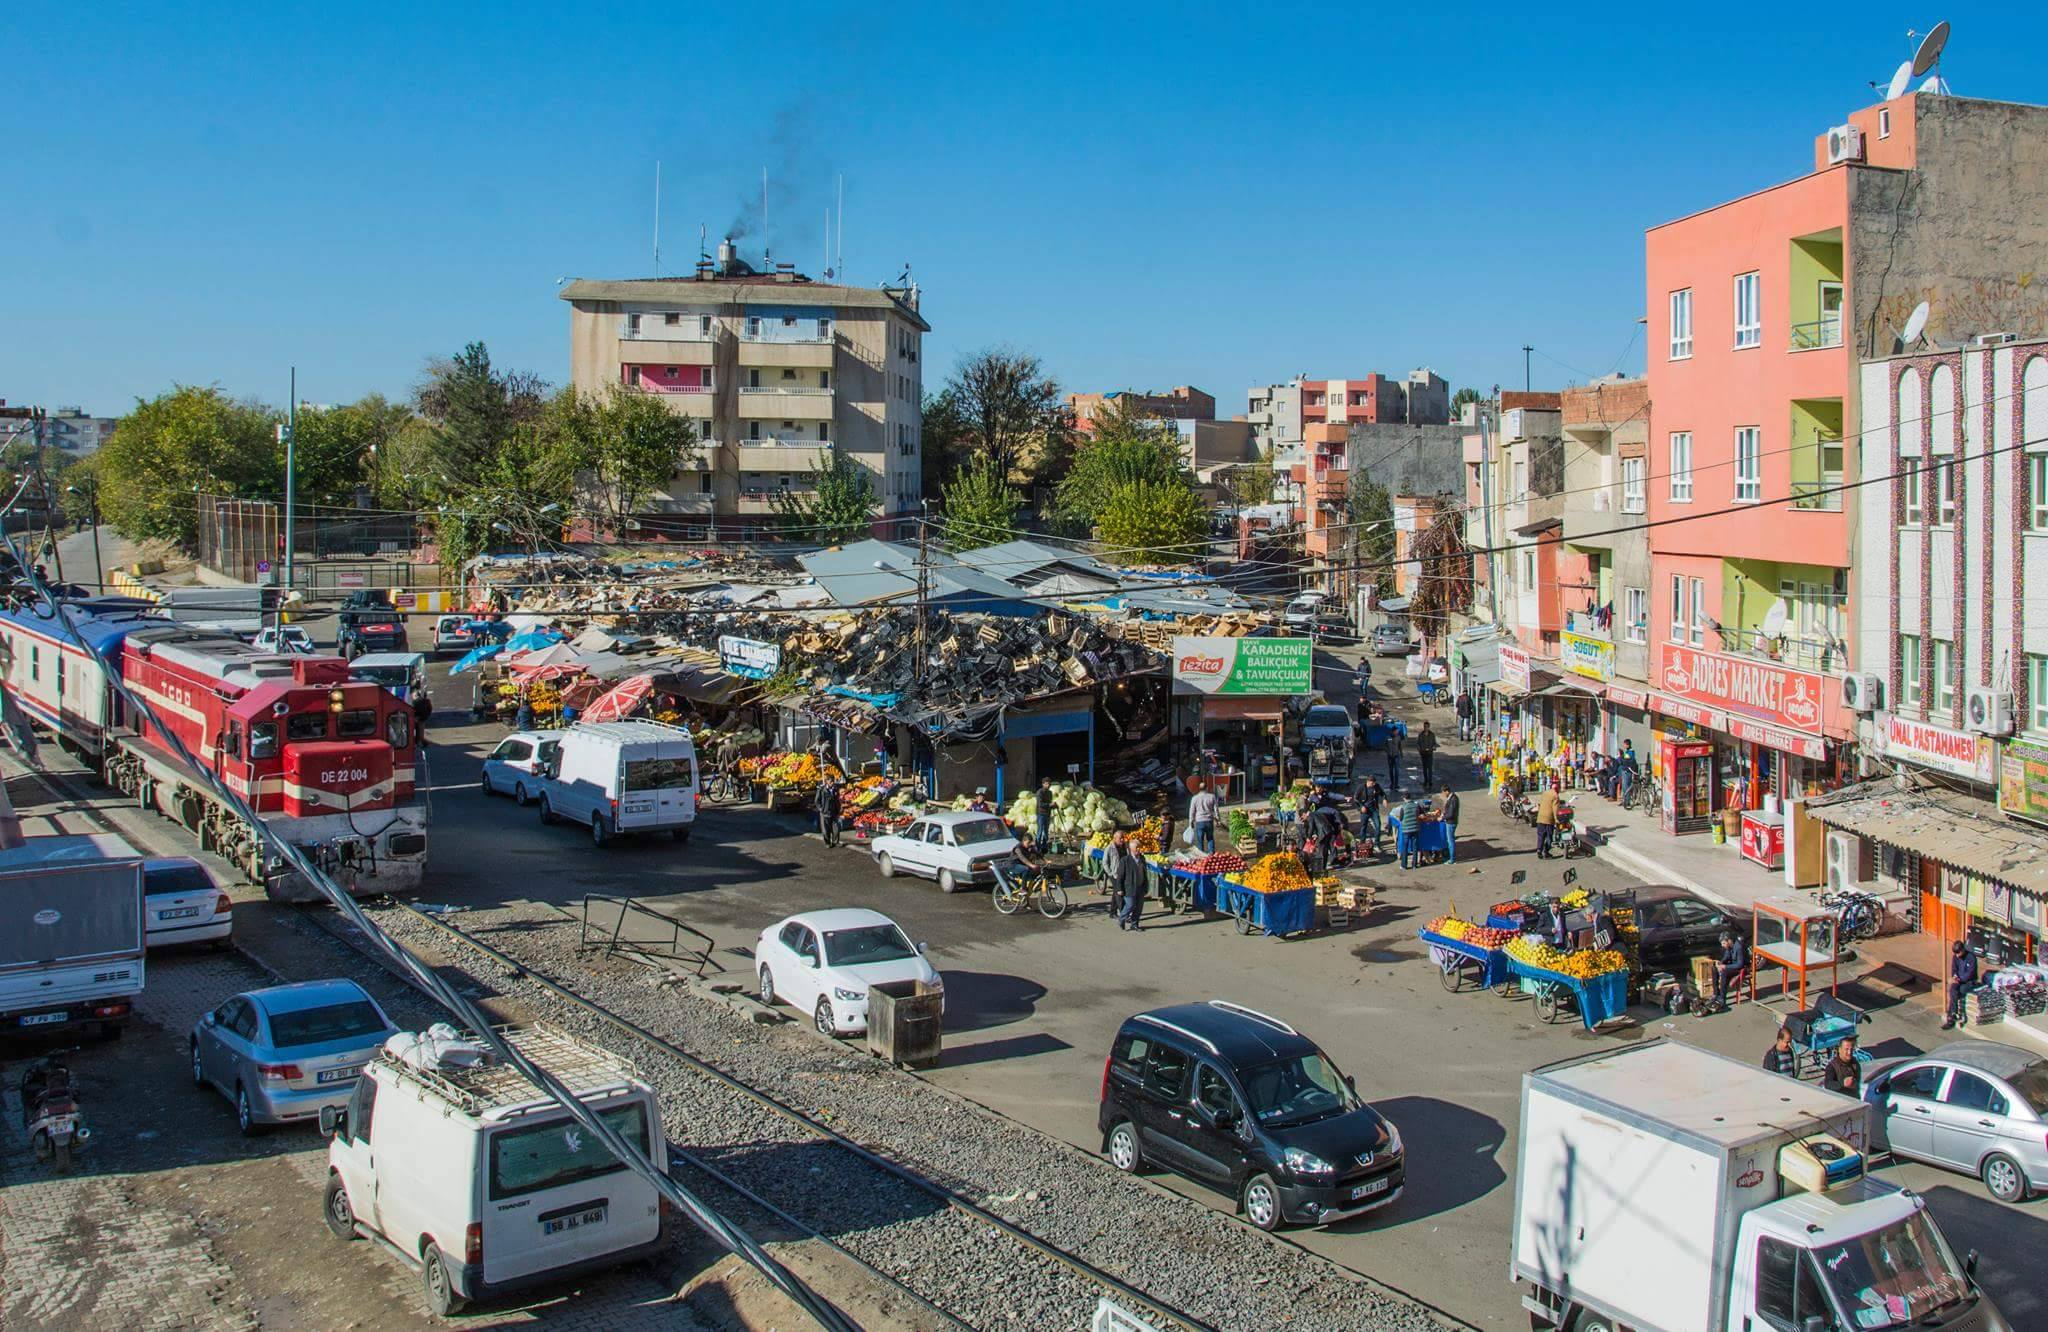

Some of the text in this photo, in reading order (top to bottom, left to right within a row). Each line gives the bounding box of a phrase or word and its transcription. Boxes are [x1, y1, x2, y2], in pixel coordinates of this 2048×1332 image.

[1242, 643, 1308, 656] KARADENİZ
[1247, 657, 1299, 669] BALIKÇILIK
[1236, 669, 1309, 681] & TAVUKÇULUK
[1691, 653, 1786, 713] ADRES MARKET
[161, 681, 191, 706] TCDD
[1742, 723, 1793, 750] ADRES MARKET
[1889, 716, 1912, 746] ÜNAL
[321, 769, 368, 783] DE 22 004
[498, 1200, 531, 1211] TRANSIT
[567, 1218, 579, 1230] AL
